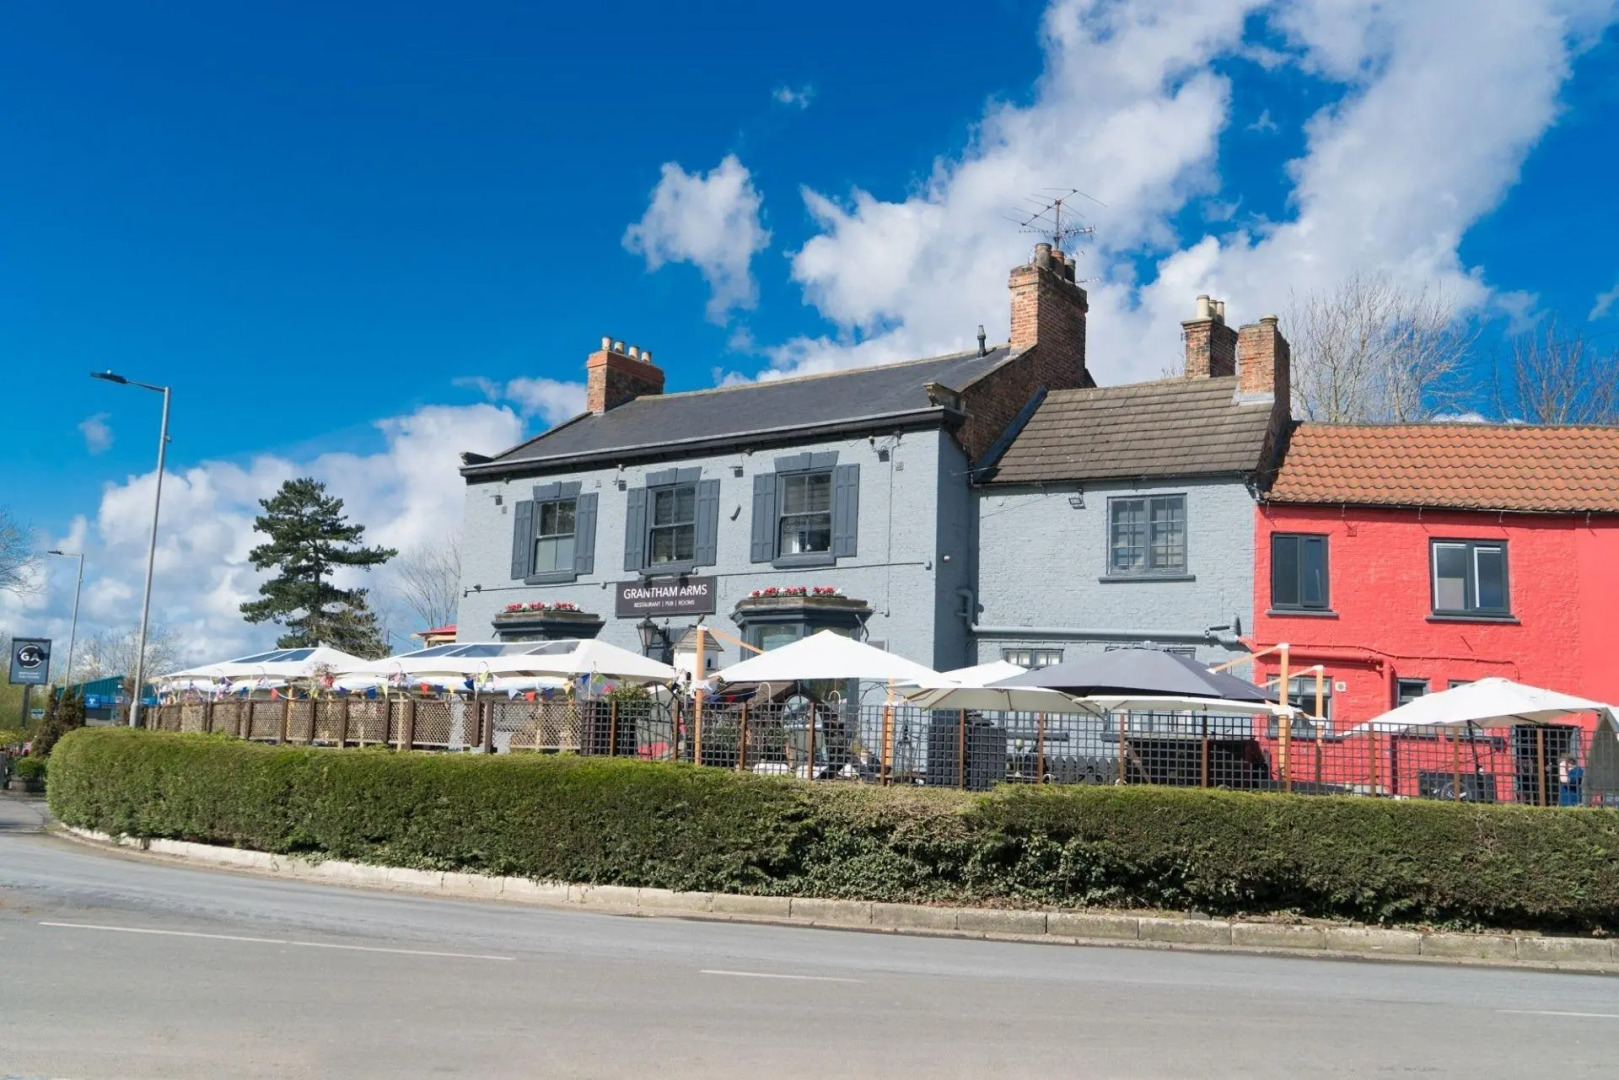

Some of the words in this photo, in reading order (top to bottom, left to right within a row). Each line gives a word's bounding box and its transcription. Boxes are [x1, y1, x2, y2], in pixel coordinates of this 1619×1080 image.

[623, 586, 677, 599] GRANTHAM
[679, 584, 708, 596] ARMS
[20, 652, 40, 662] GA
